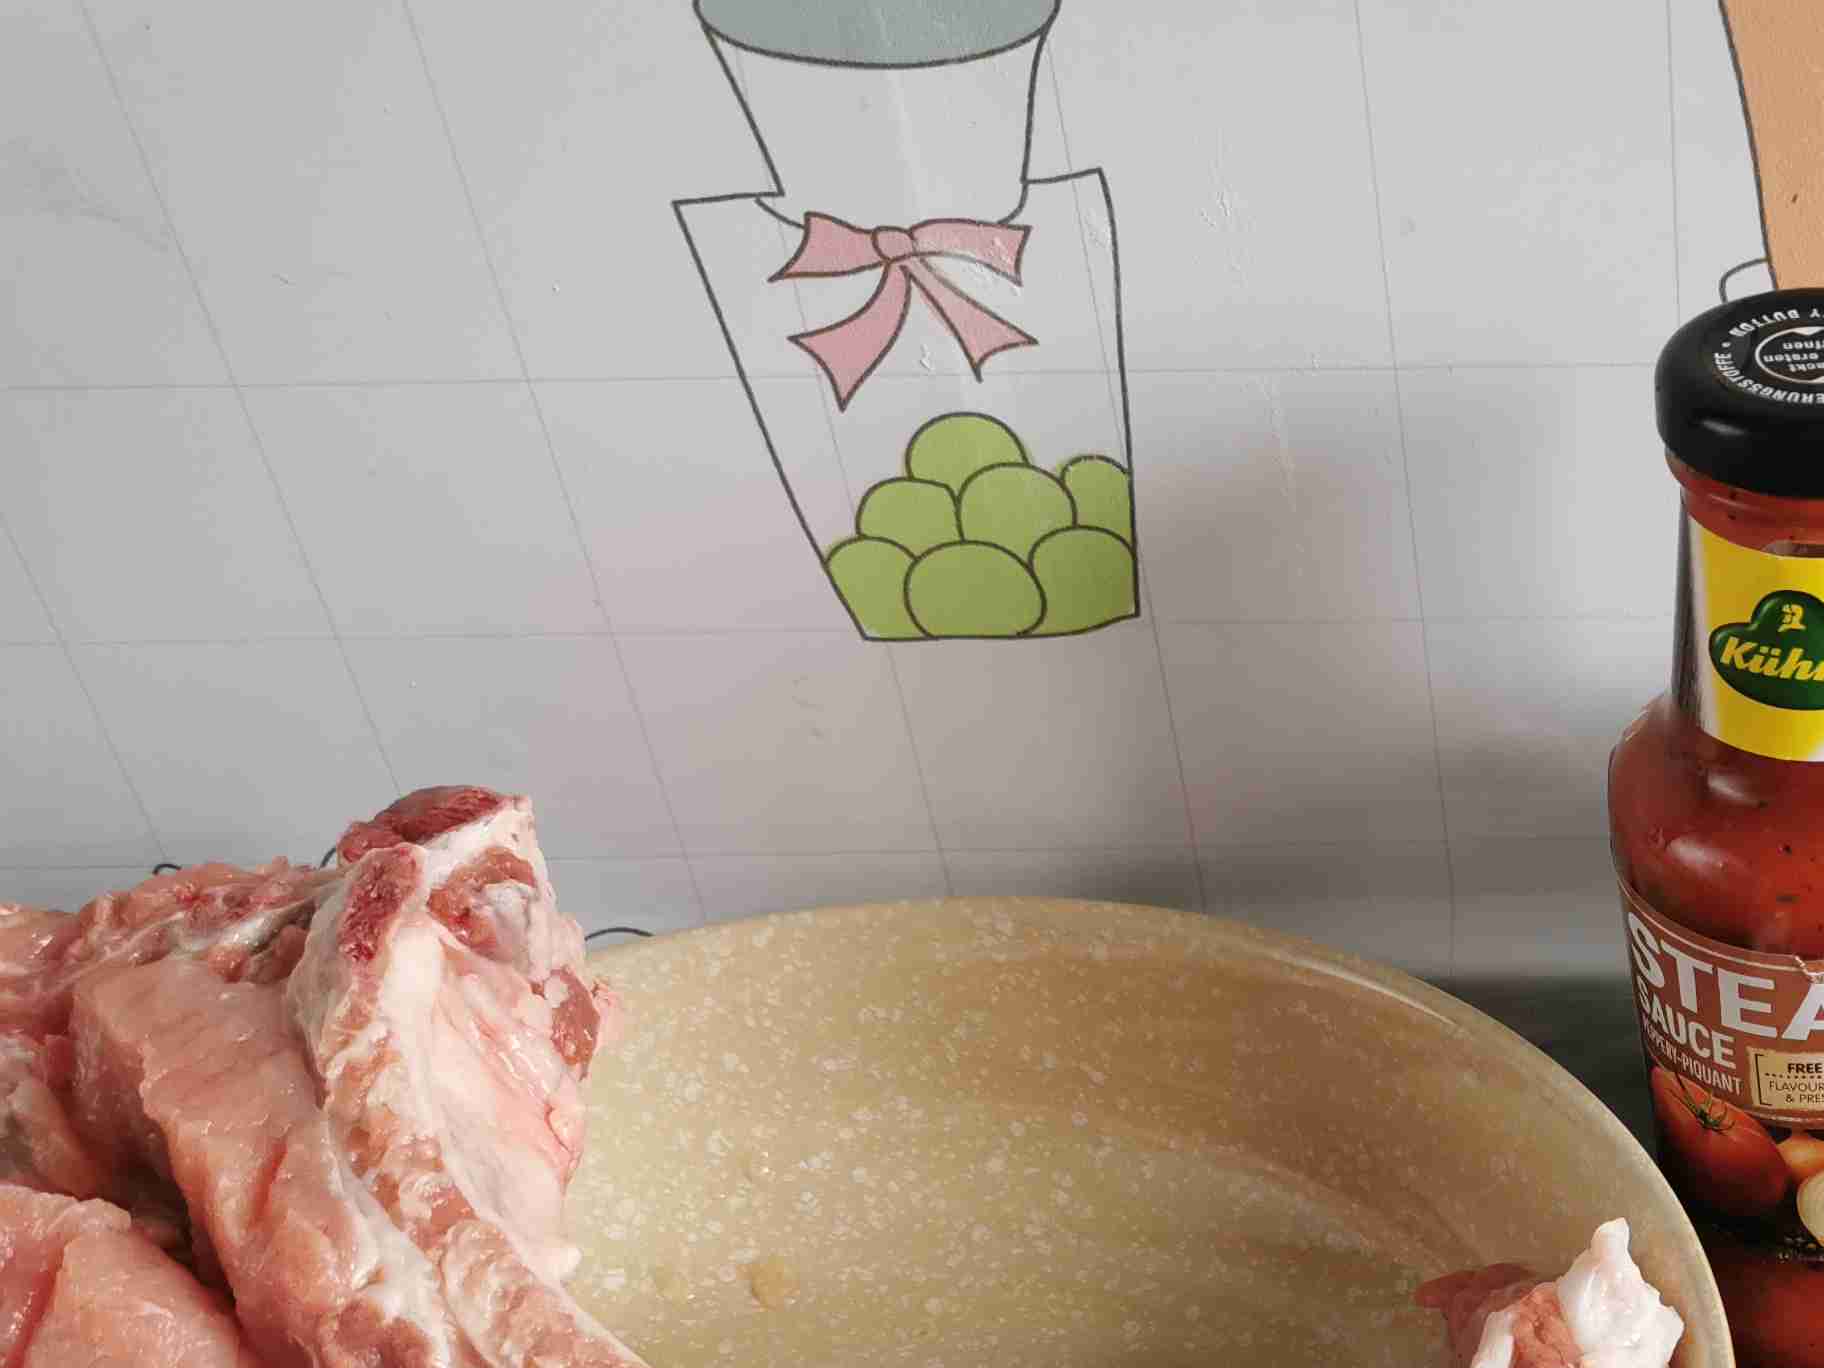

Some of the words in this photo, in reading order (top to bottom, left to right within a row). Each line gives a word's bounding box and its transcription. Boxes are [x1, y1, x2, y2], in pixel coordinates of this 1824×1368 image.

[1728, 308, 1800, 338] BUTTON
[1635, 974, 1737, 1071] SAUCE
[1787, 1062, 1824, 1075] FREE
[1785, 1093, 1794, 1104] &
